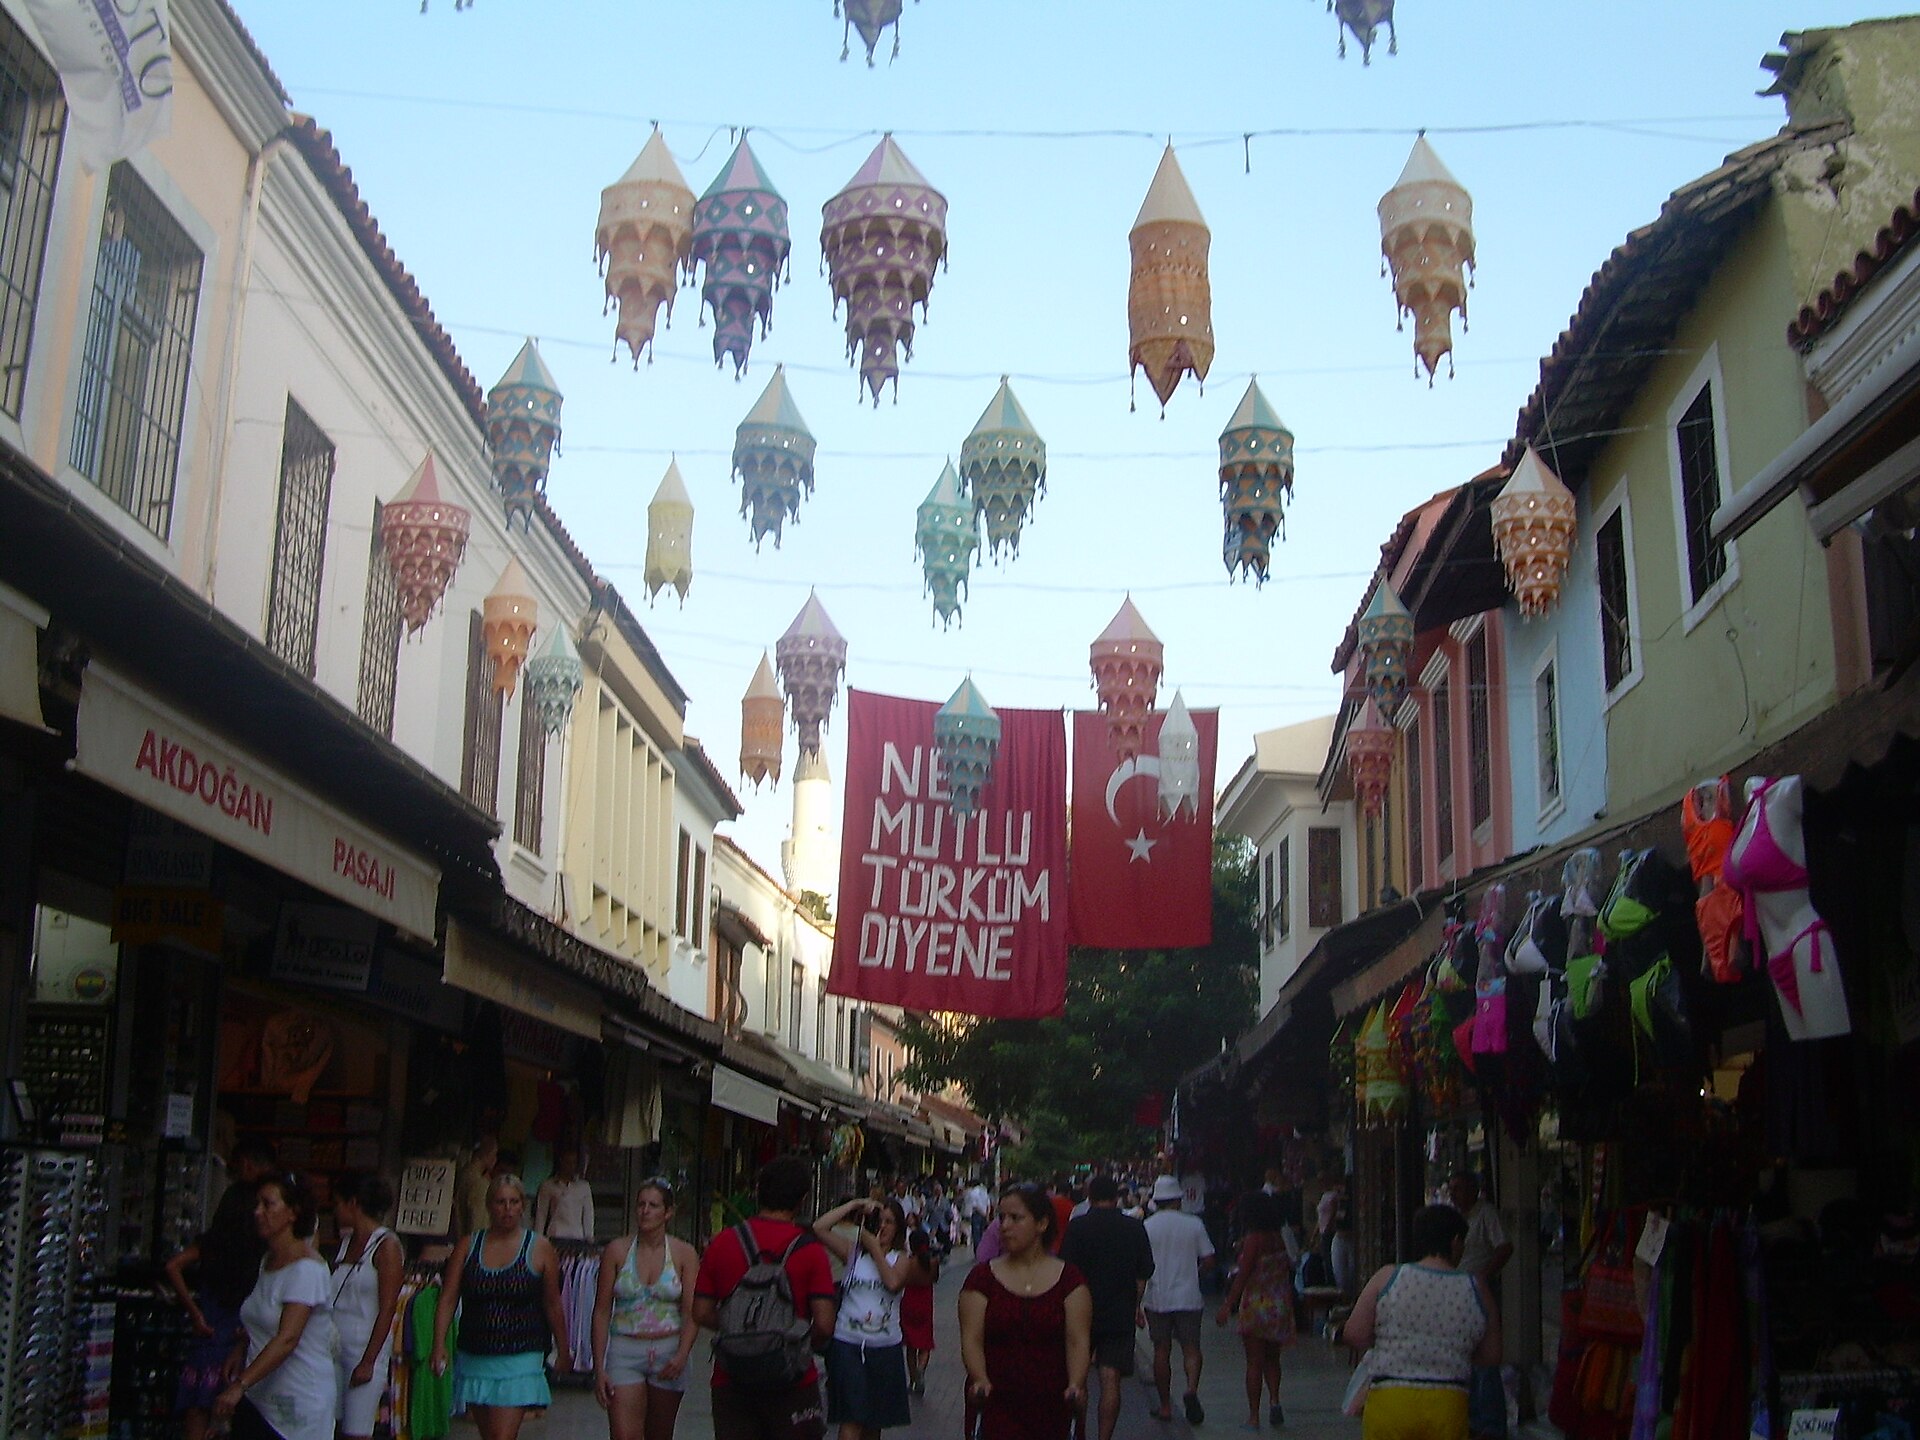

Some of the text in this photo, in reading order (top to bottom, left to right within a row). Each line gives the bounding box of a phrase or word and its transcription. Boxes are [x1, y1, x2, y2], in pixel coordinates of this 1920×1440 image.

[881, 741, 954, 802] NE
[135, 728, 396, 901] AKDOĞAN PASAJI
[870, 797, 1032, 866] MUTLU
[120, 898, 205, 927] BIG SALE
[862, 854, 1050, 923] TÜRKÜM
